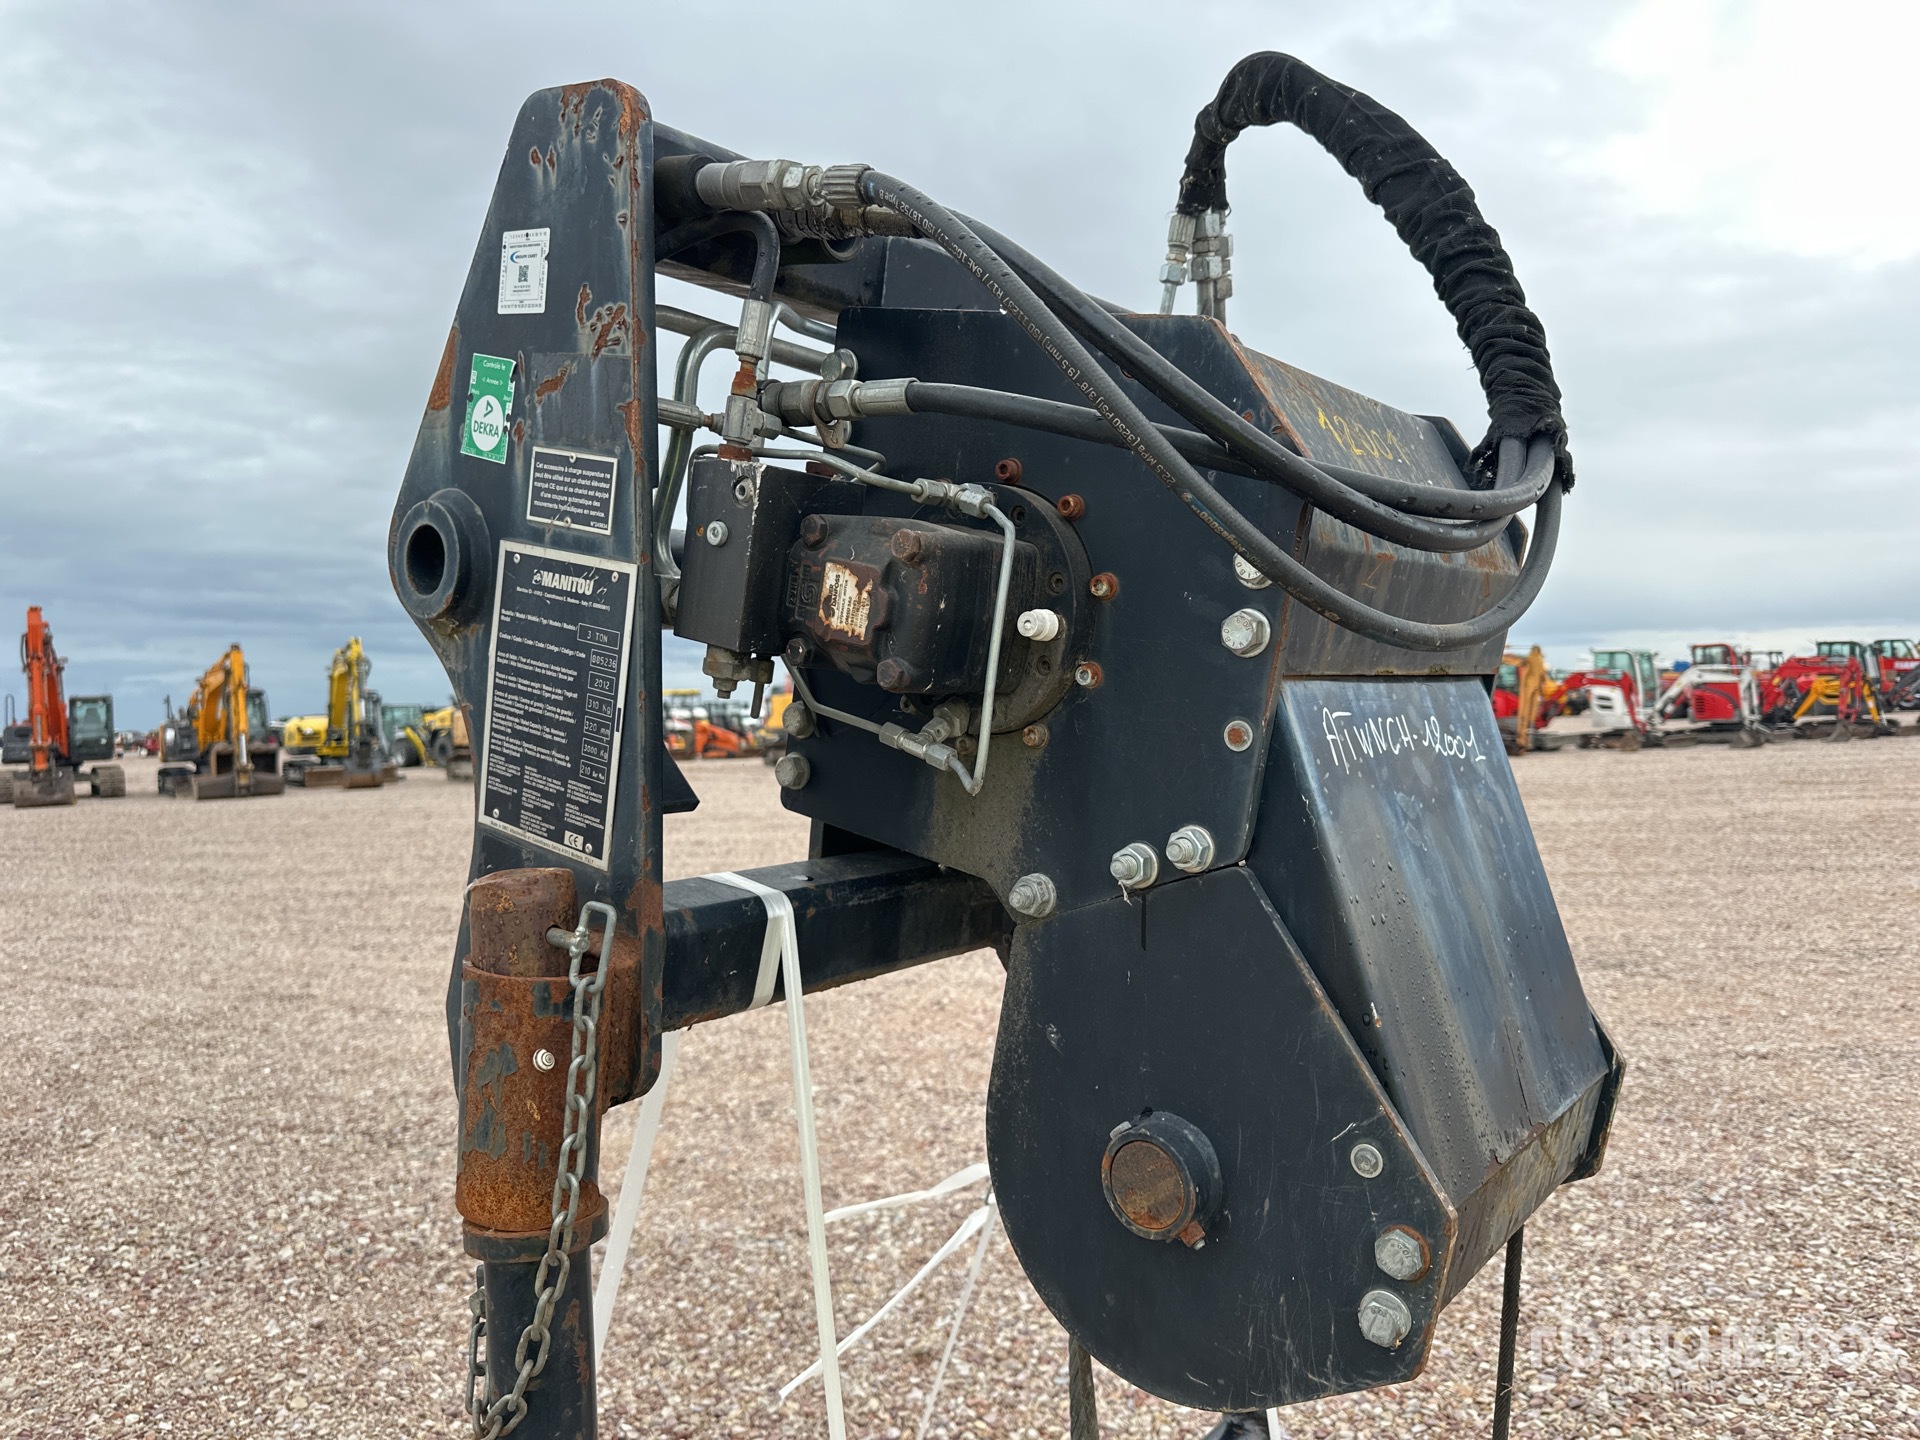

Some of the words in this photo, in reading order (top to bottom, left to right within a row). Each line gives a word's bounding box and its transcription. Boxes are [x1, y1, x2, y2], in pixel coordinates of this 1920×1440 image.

[879, 188, 884, 199] B
[884, 193, 901, 210] Type
[901, 202, 922, 224] 18752
[923, 218, 935, 234] ISO
[968, 258, 983, 278] SAE
[987, 279, 1004, 300] R17
[1003, 295, 1028, 328] 11237
[1027, 323, 1042, 342] ISO
[483, 360, 501, 369] Contrôle
[473, 421, 499, 438] DEKRA
[1138, 445, 1157, 464] MPa
[543, 464, 564, 472] accessoire
[583, 470, 604, 478] suspendue
[1157, 463, 1176, 487] 22.5
[591, 480, 610, 489] élévateur
[552, 494, 568, 502] coupure
[568, 496, 592, 506] automatique
[574, 487, 588, 495] chariot
[595, 491, 609, 499] équipé
[534, 501, 558, 509] mouvements
[559, 504, 583, 513] hydrauliques
[541, 571, 593, 595] MANITOU
[832, 574, 841, 607] DANFOSS
[586, 630, 591, 639] 3
[595, 632, 608, 643] TON
[513, 635, 522, 643] Code
[535, 640, 544, 648] Code
[575, 650, 585, 658] Code
[594, 678, 609, 690] 2012
[587, 698, 599, 711] 310
[585, 720, 597, 731] 320
[583, 744, 597, 756] 3000
[580, 764, 590, 775] 210
[568, 833, 578, 847] CE
